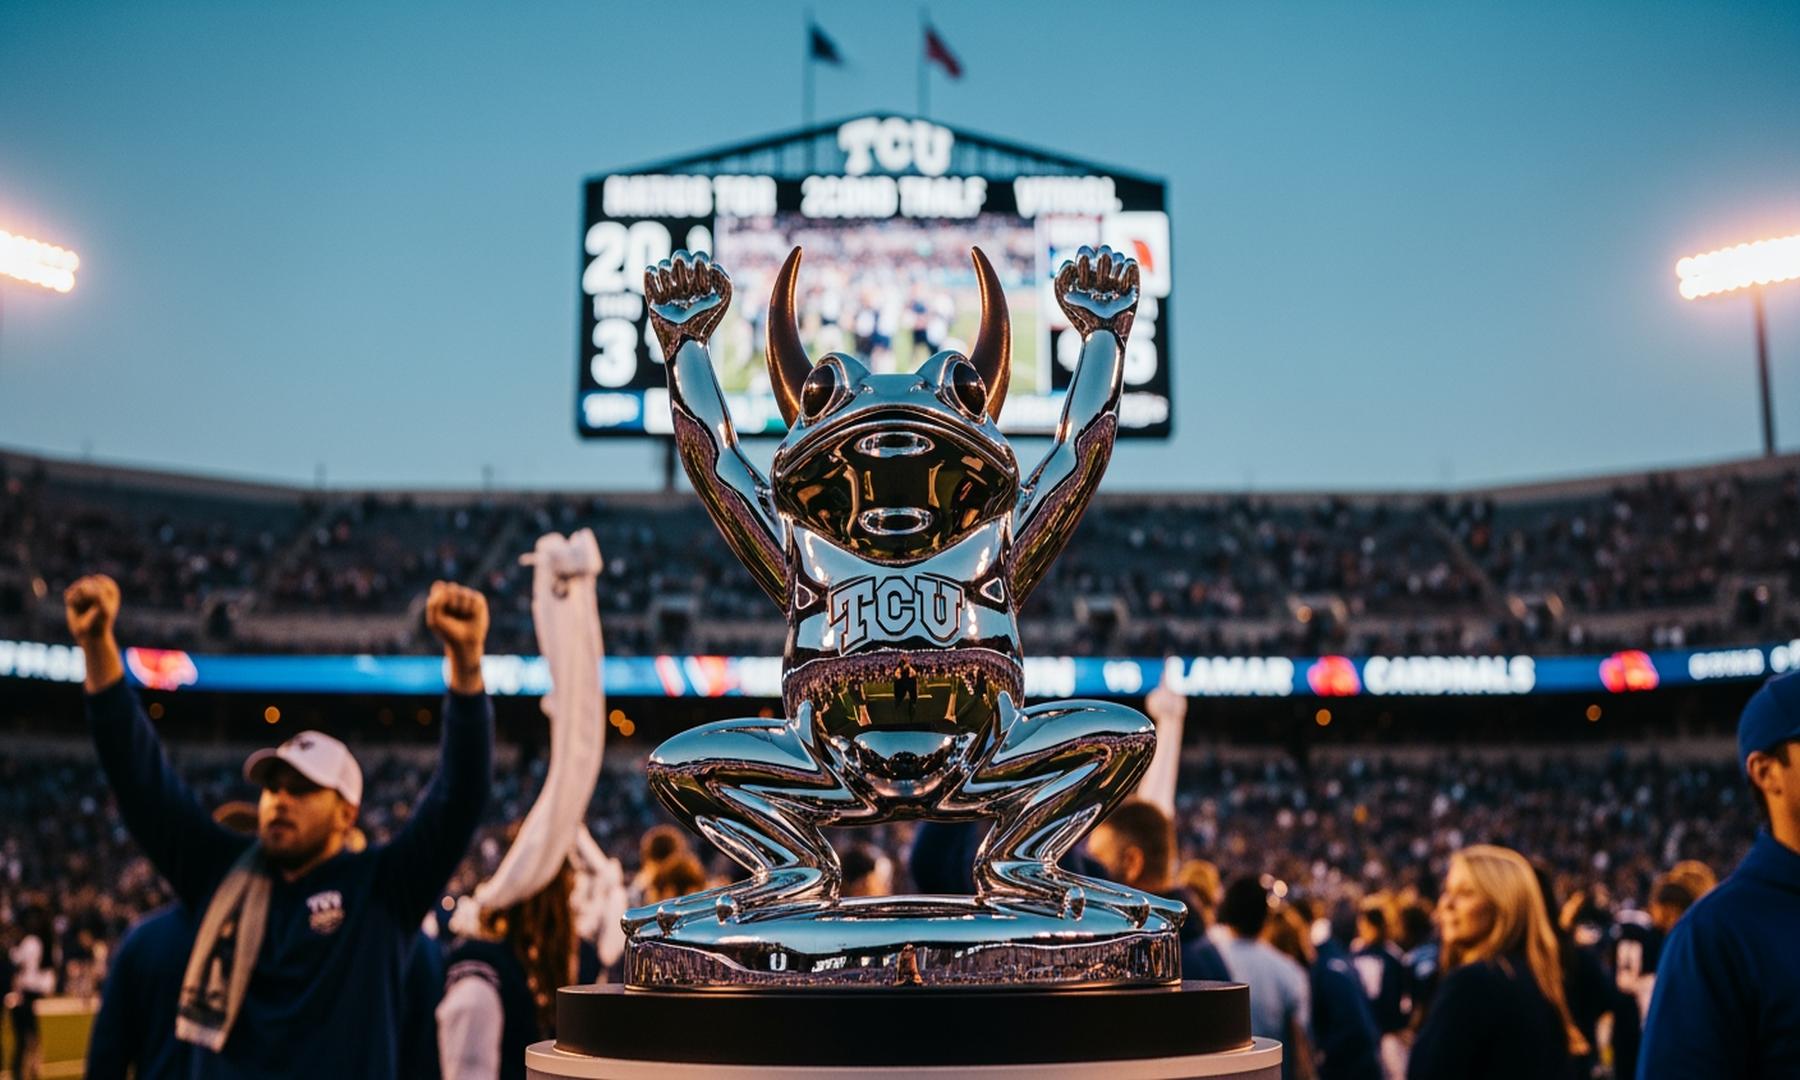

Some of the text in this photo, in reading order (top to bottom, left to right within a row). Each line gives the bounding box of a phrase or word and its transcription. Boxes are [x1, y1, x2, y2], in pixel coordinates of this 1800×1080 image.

[838, 117, 954, 176] TCU
[591, 318, 638, 387] 3
[829, 574, 965, 656] TCU
[1165, 656, 1294, 696] LAMAR
[1363, 655, 1536, 696] CARDINALS
